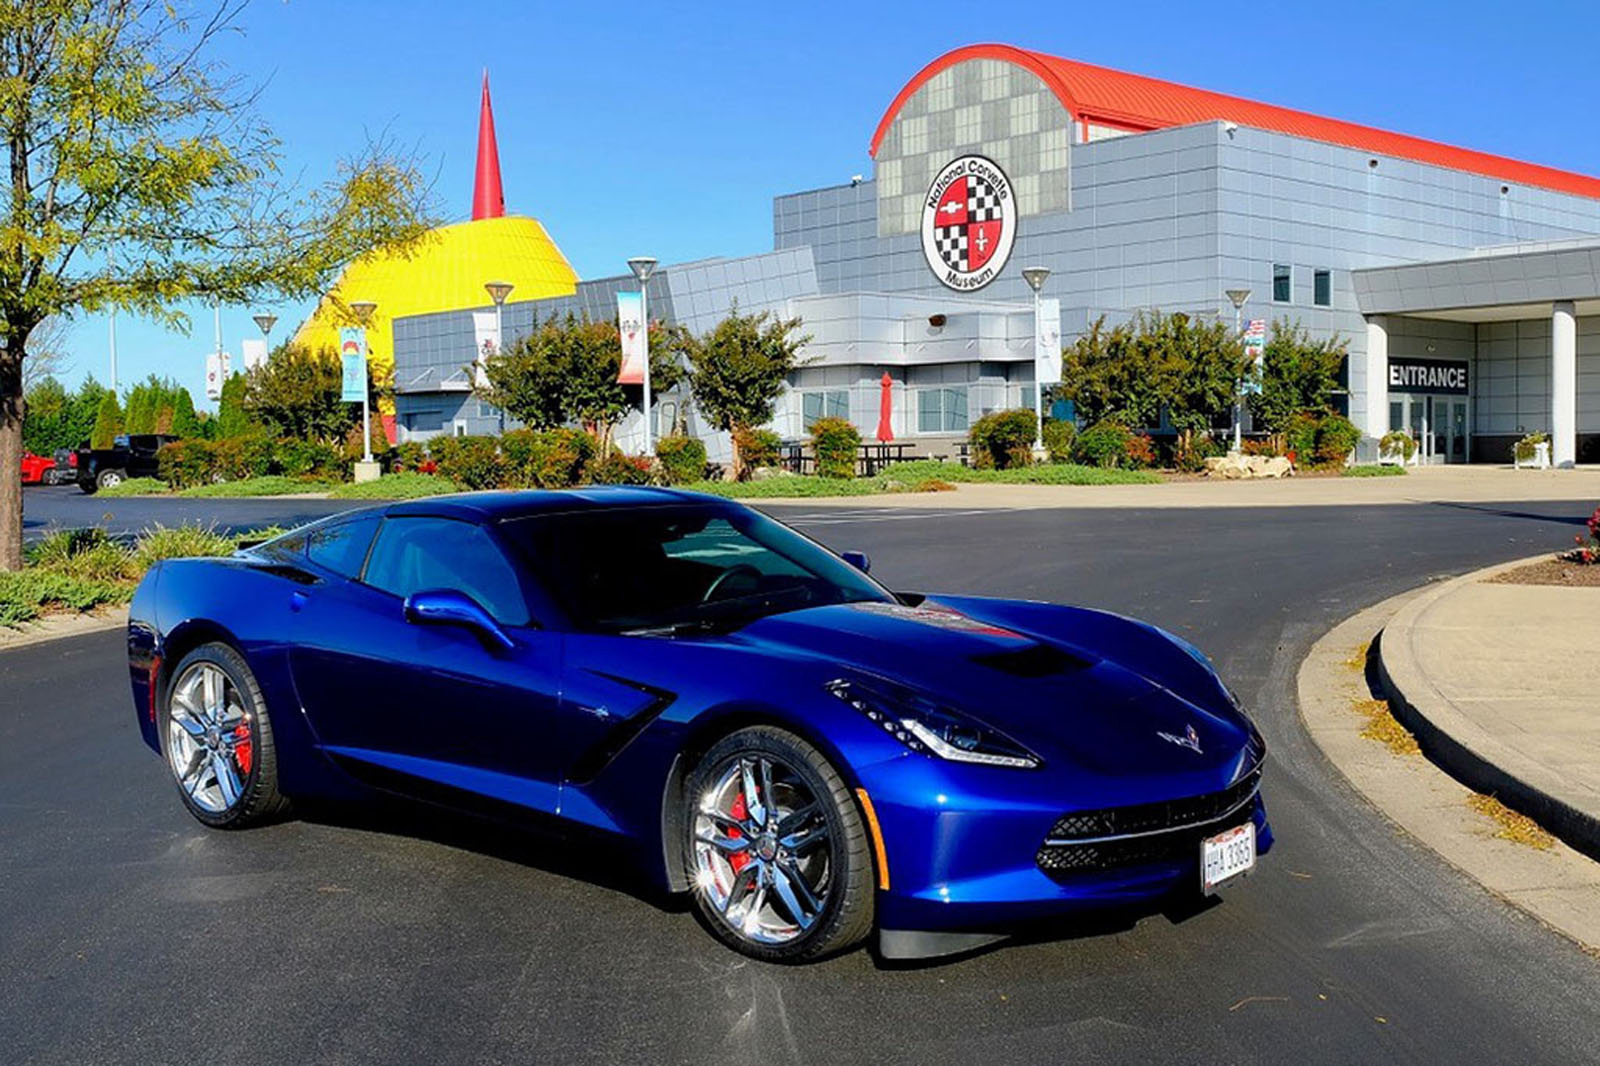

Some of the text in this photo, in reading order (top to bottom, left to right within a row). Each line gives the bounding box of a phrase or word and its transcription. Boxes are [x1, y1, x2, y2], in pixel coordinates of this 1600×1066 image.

[928, 160, 1009, 209] National Corvette
[945, 267, 994, 288] Museum
[1390, 365, 1466, 388] ENTRANCE
